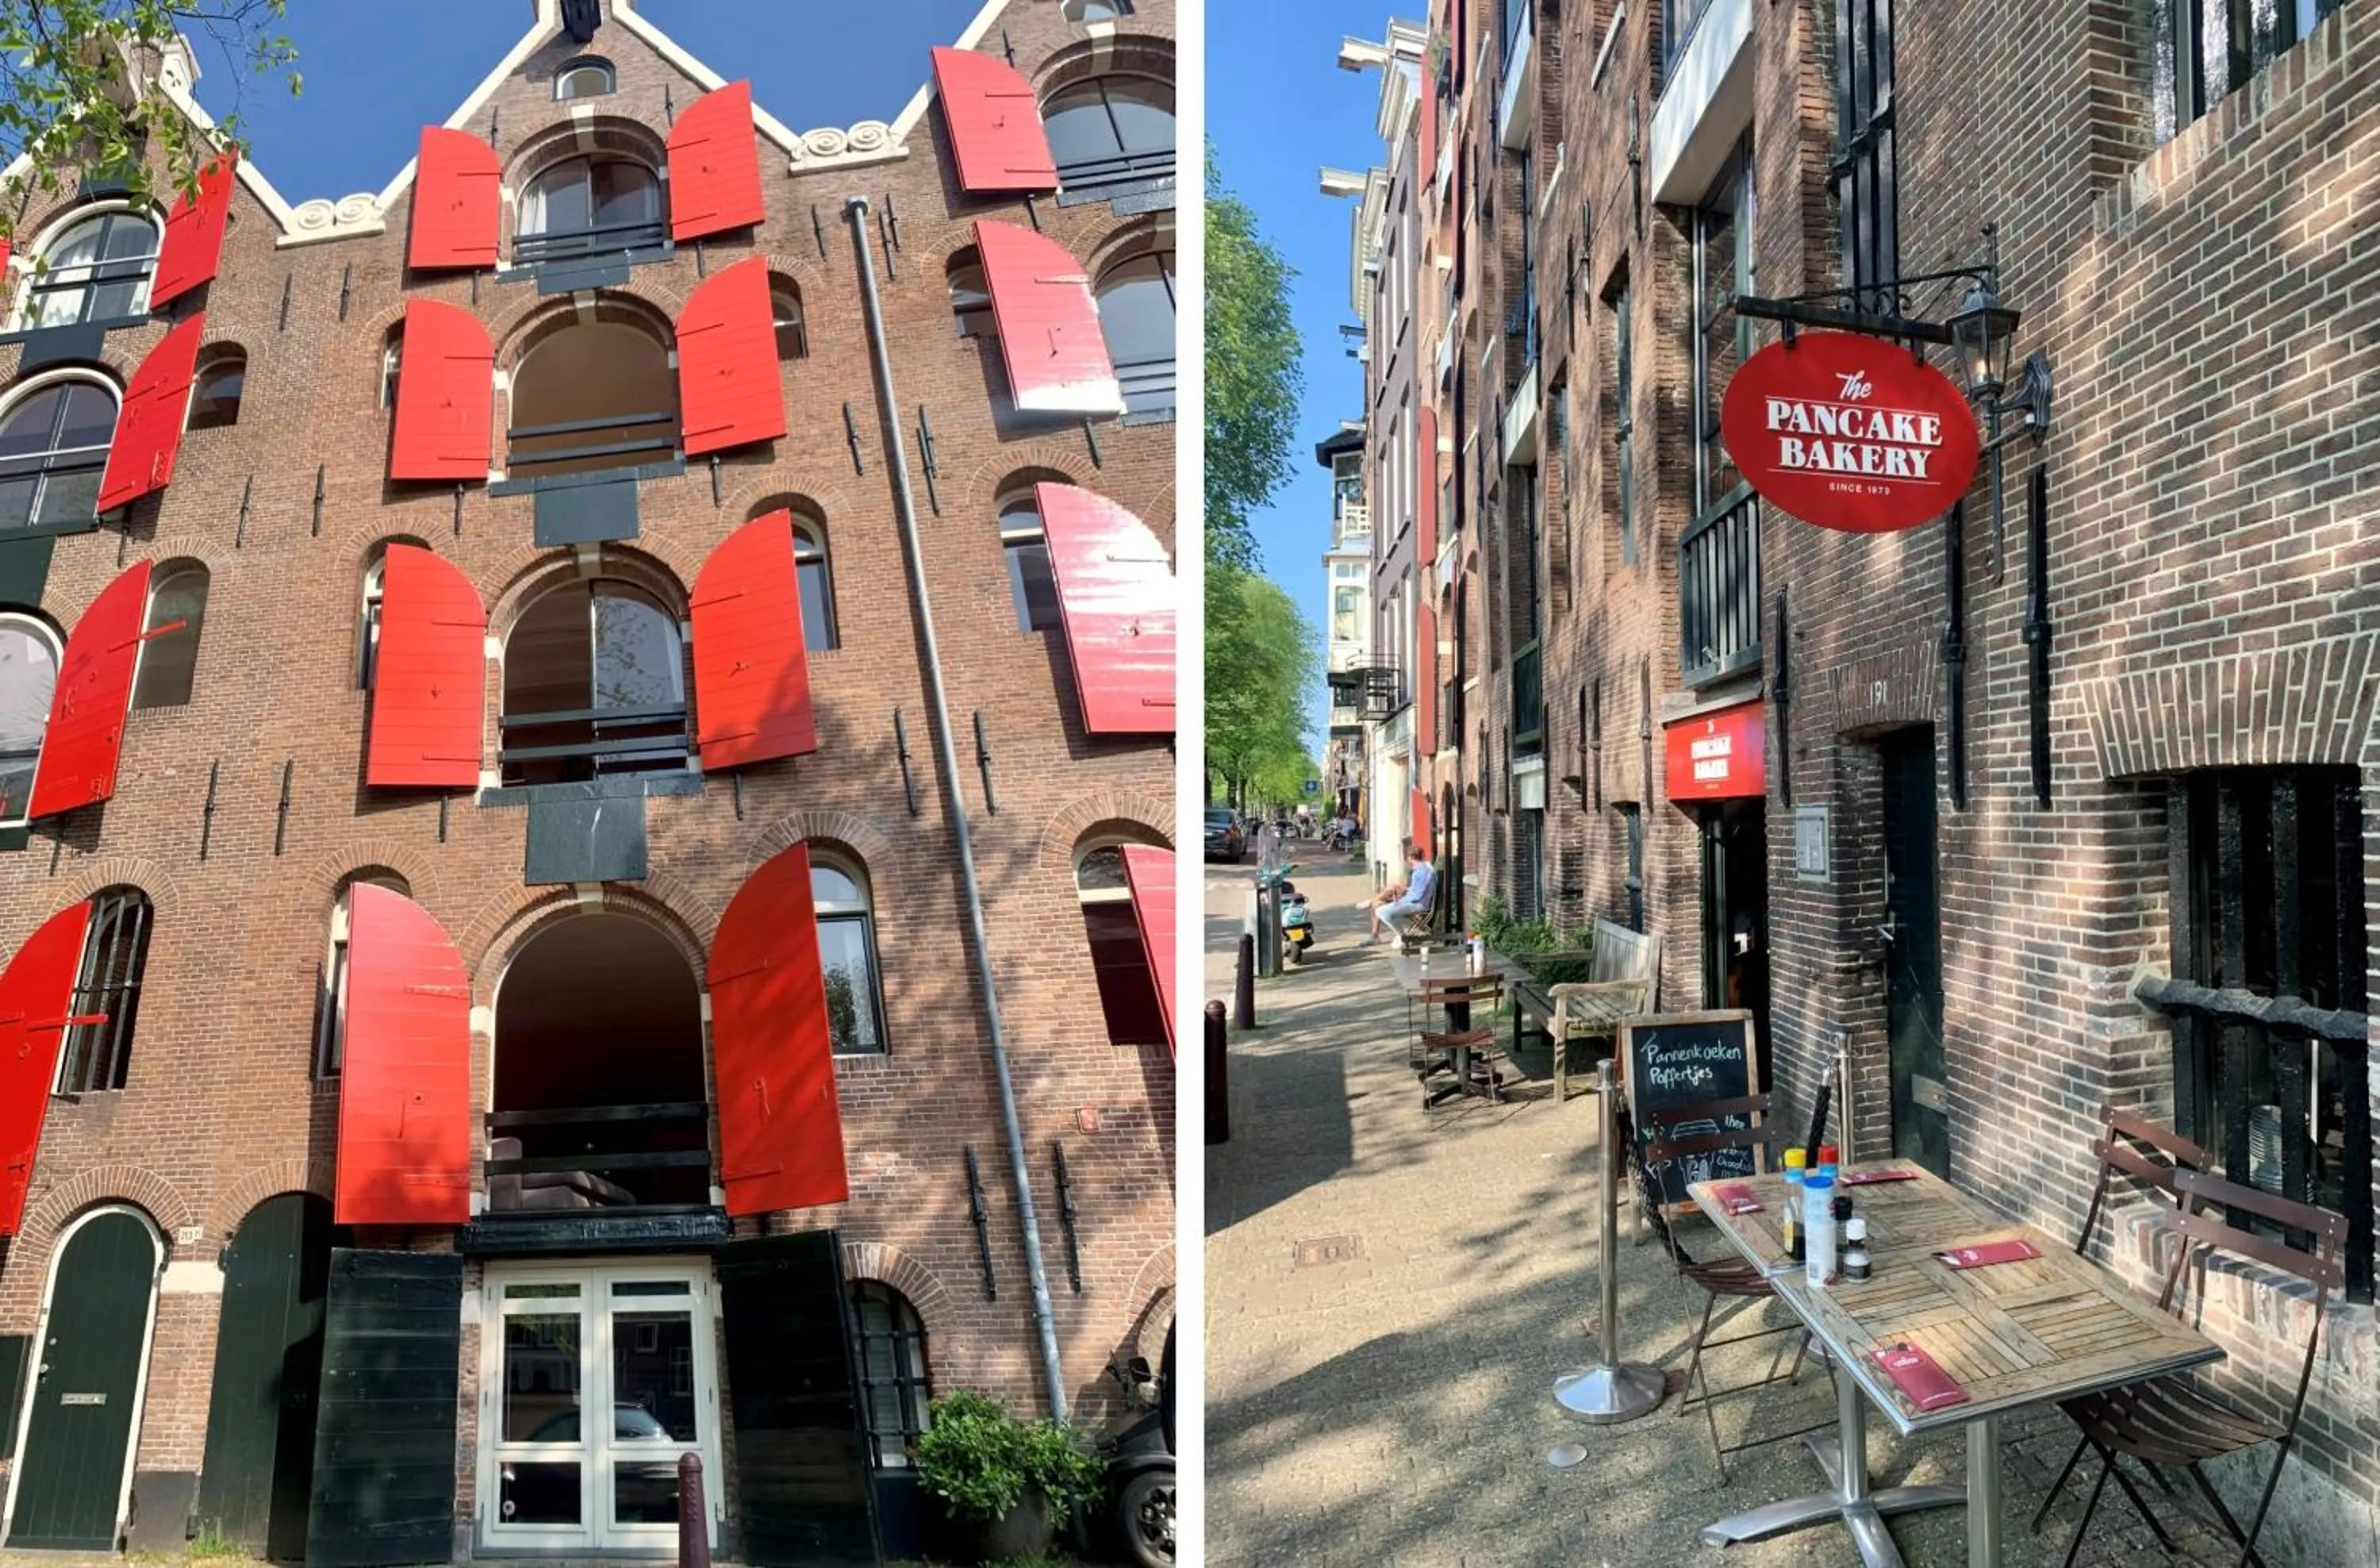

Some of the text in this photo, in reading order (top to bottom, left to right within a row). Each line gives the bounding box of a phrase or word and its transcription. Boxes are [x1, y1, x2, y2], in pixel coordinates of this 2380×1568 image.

[1836, 370, 1873, 400] The
[1765, 399, 1943, 446] PANCAKE
[1779, 437, 1932, 478] BAKERY
[1829, 482, 1862, 493] SINCE
[1870, 680, 1887, 706] 191
[1647, 1038, 1742, 1064] Pannenkoeken
